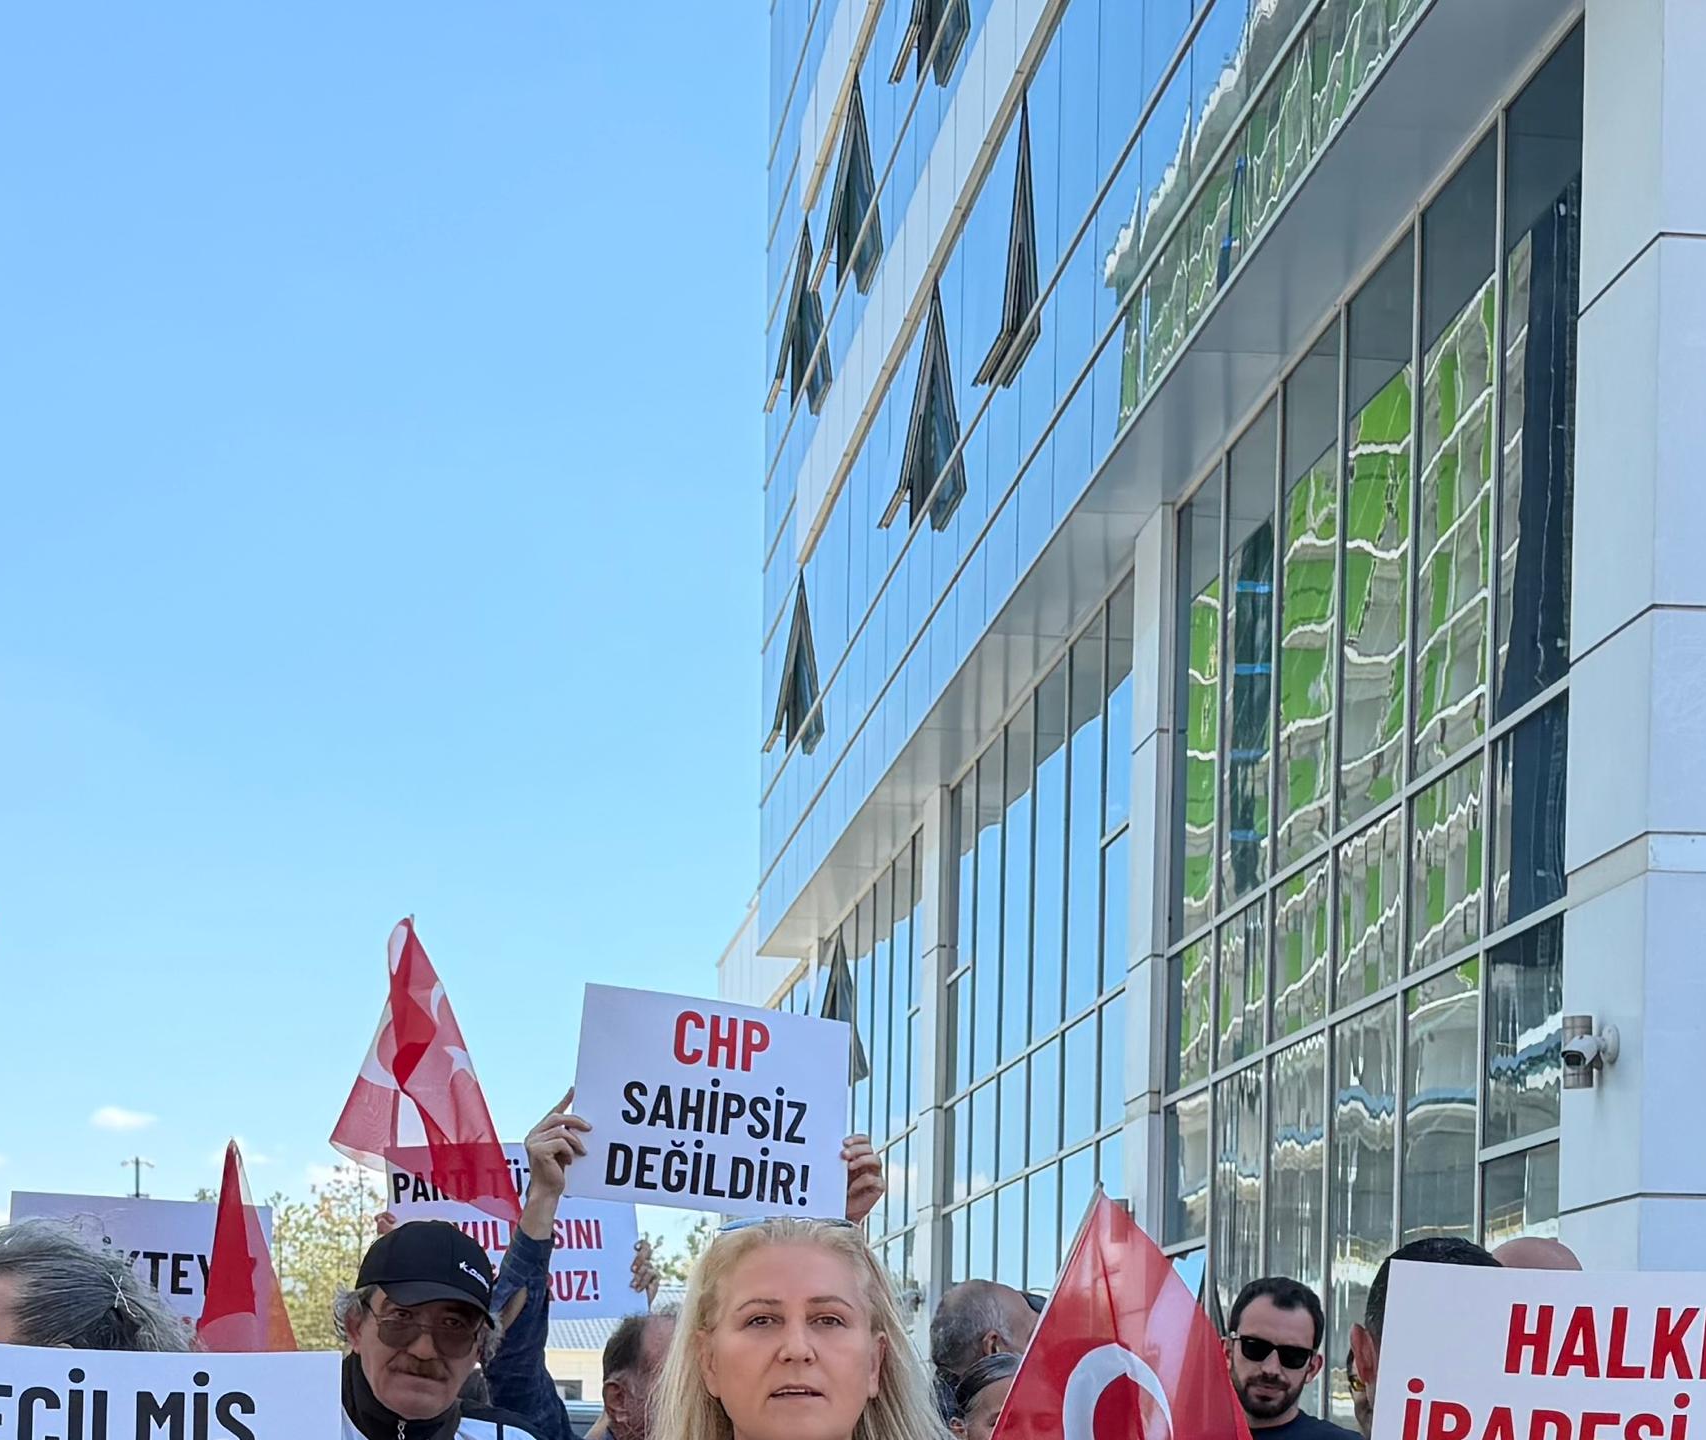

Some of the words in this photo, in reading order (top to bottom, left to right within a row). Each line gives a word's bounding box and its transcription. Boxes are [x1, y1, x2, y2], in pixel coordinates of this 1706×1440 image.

[674, 1011, 769, 1072] CHP
[622, 1078, 806, 1144] SAHİPSİZ
[605, 1140, 809, 1206] DEĞİLDİR!
